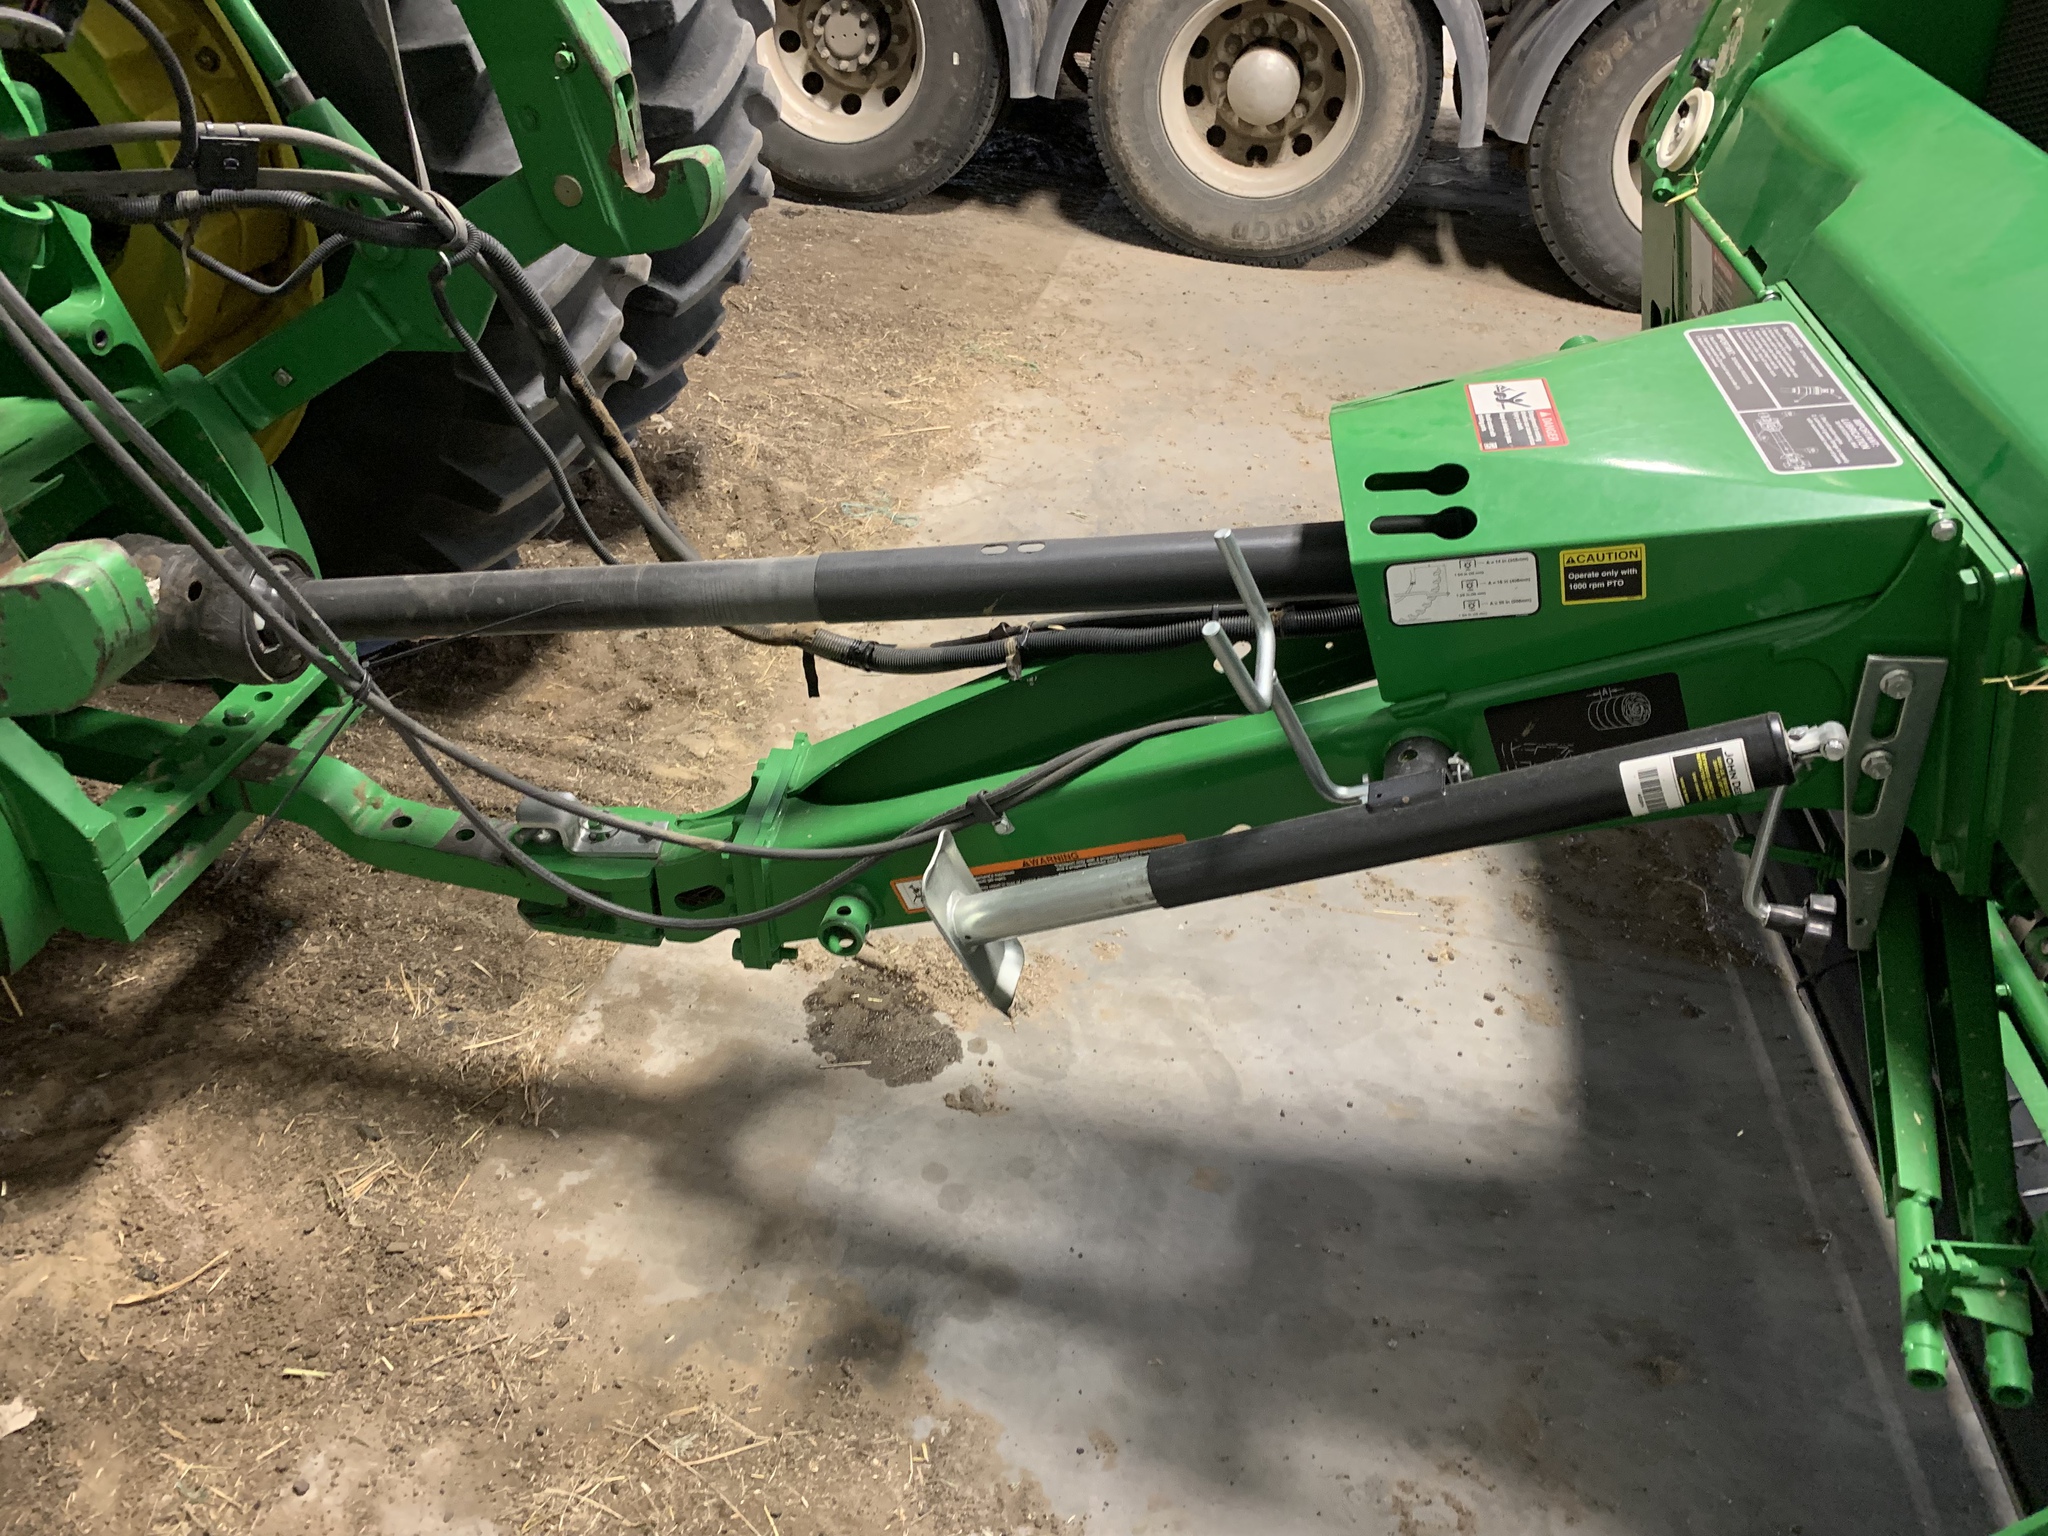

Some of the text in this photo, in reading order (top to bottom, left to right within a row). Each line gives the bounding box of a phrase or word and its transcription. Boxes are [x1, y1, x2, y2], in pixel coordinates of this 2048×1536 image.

[1576, 549, 1638, 564] CAUTION
[1568, 567, 1638, 580] Operate only with
[1569, 579, 1624, 590] 1000 rpm PTO
[1724, 751, 1738, 780] JOHN
[1030, 851, 1079, 867] WARNING
